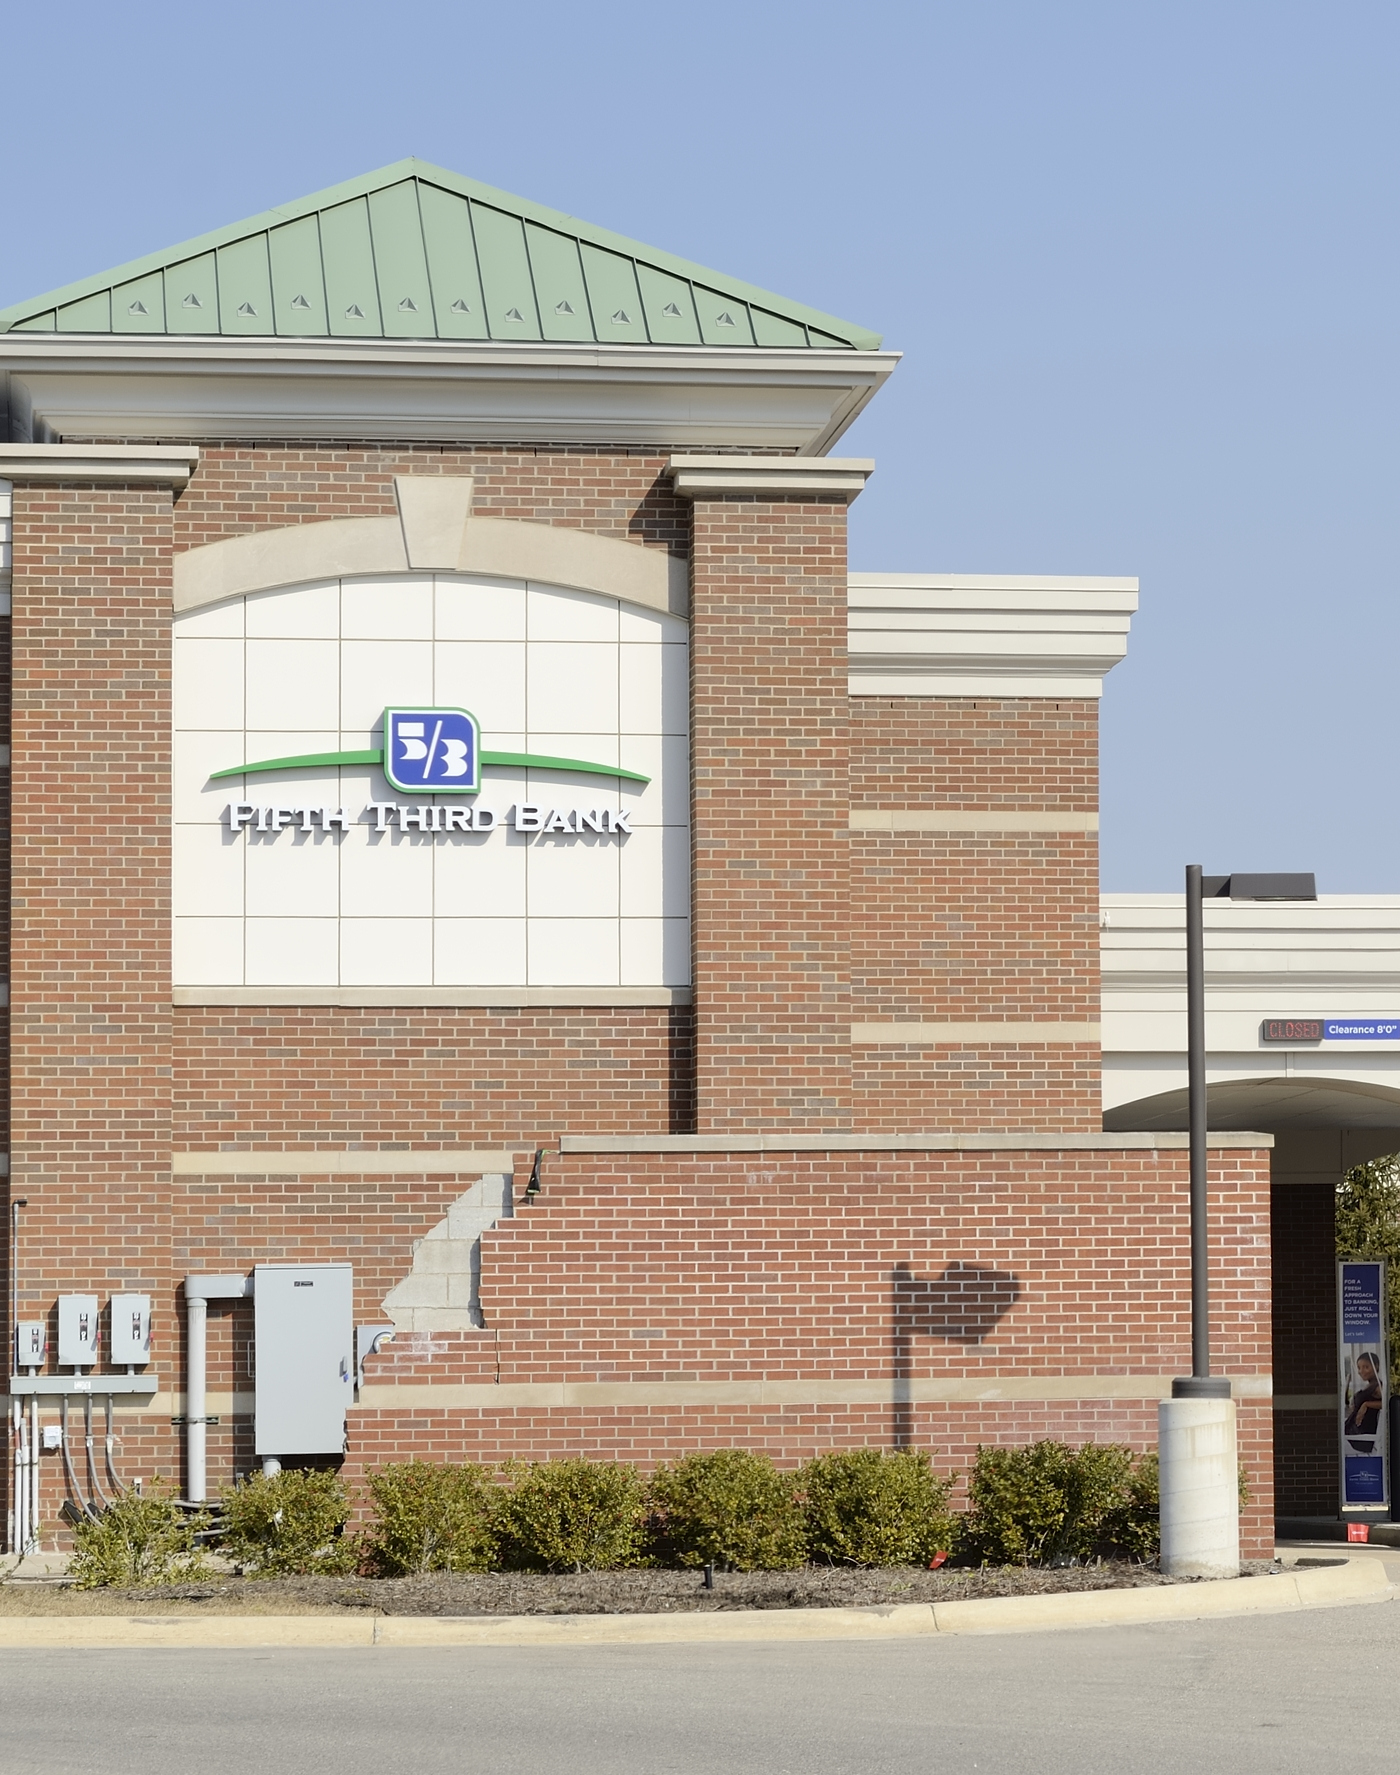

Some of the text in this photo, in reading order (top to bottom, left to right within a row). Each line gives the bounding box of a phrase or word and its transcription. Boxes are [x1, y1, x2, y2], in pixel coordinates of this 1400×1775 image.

[229, 801, 633, 833] FIFTH THIRD BANK
[1269, 1022, 1319, 1038] CLOSED
